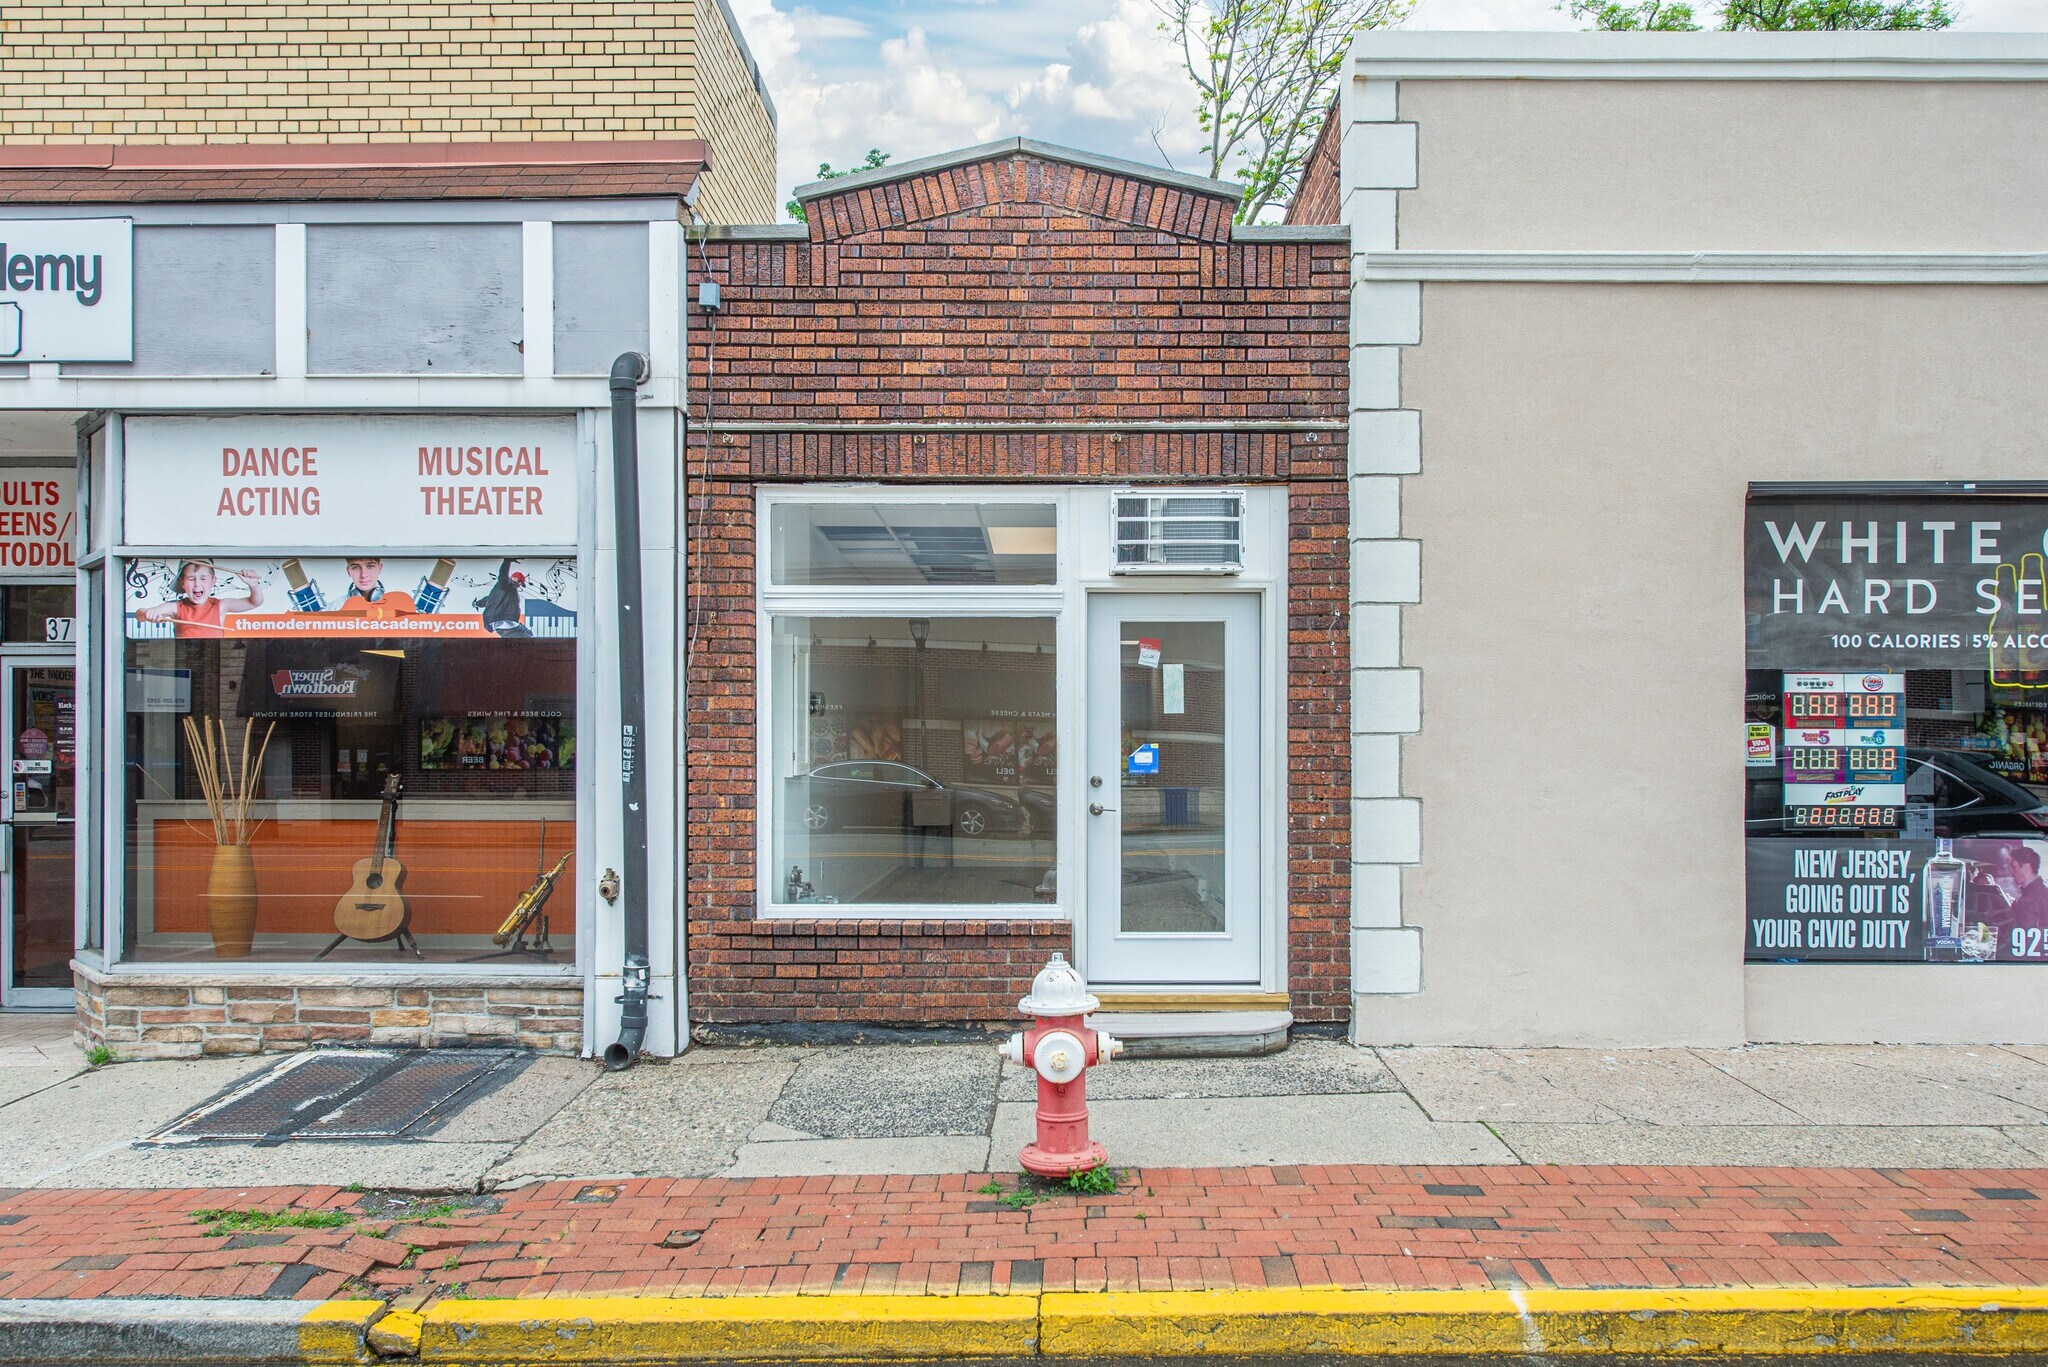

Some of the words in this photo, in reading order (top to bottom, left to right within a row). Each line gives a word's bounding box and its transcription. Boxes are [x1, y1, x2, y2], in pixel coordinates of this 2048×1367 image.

[222, 447, 318, 477] DANCE
[418, 446, 549, 476] MUSICAL
[0, 481, 60, 506] ULTS
[217, 486, 321, 516] ACTING
[420, 486, 543, 515] THEATER
[1764, 521, 2002, 564] WHITE
[1773, 579, 1938, 615] HARD
[1975, 579, 2042, 615] SE
[48, 618, 71, 641] 37
[235, 616, 480, 633] themodernmusicacademy.com
[1831, 634, 1862, 649] 100
[1868, 634, 1961, 649] CALORIES
[1972, 634, 1998, 649] 5%
[33, 690, 56, 702] VOICE
[1749, 744, 1770, 752] Card
[1873, 730, 1886, 745] 6
[1824, 791, 1843, 801] FAST
[1794, 850, 1837, 878] NEW
[1841, 850, 1916, 884] JERSEY,
[1785, 884, 1847, 914] GOING
[1849, 885, 1886, 914] OUT
[1891, 885, 1910, 914] IS
[1753, 919, 1801, 948] YOUR
[1807, 919, 1856, 948] CIVIC
[1858, 920, 1910, 949] DUTY
[2012, 927, 2042, 957] 92
